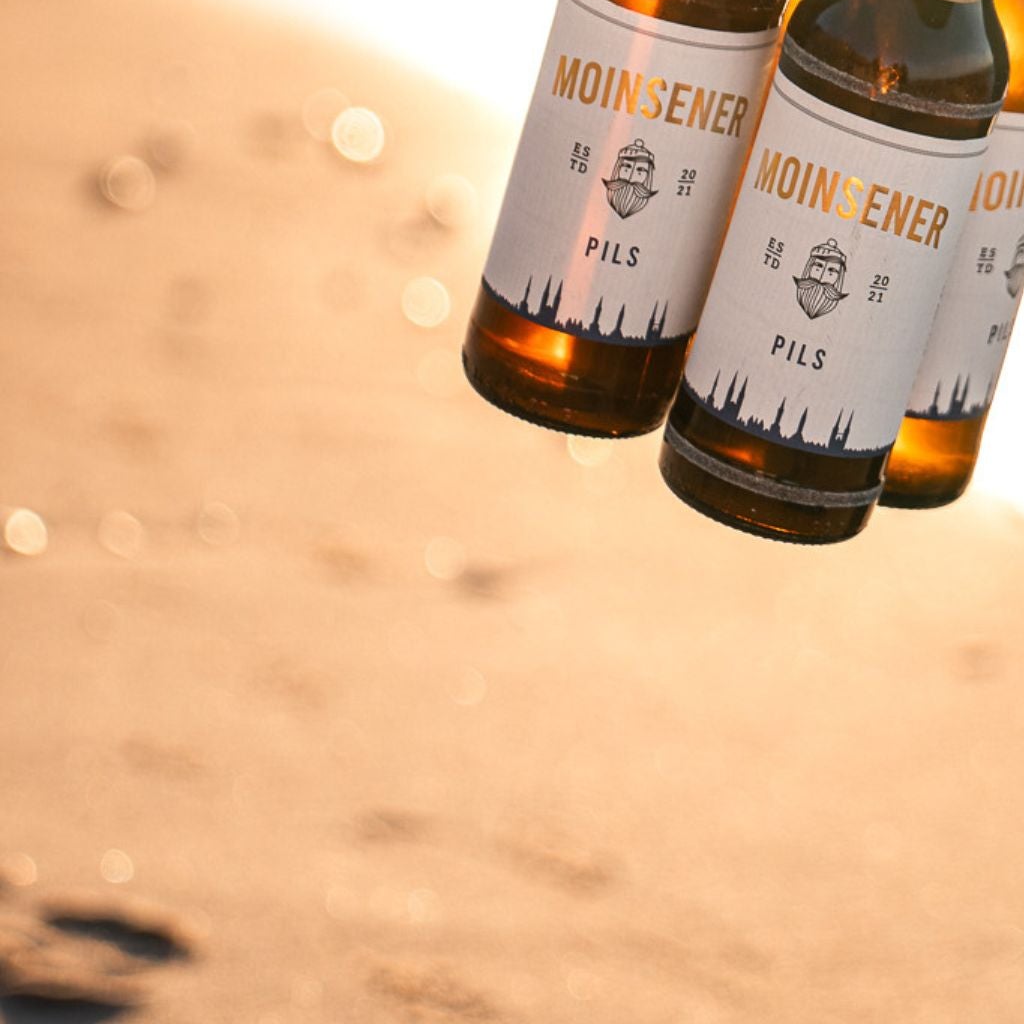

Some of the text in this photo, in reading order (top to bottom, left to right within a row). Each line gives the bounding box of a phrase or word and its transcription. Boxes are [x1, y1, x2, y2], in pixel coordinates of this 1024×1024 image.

[552, 55, 749, 138] MOINSENER
[573, 141, 592, 157] ES
[569, 158, 588, 174] TD
[681, 169, 697, 180] 20
[676, 185, 691, 196] 21
[754, 147, 949, 250] MOINSENER
[584, 236, 641, 267] PILS
[767, 237, 785, 252] ES
[979, 247, 997, 258] ES
[763, 253, 781, 270] TD
[976, 262, 994, 274] TD
[873, 275, 890, 287] 20
[867, 291, 884, 303] 21
[770, 334, 827, 370] PILS
